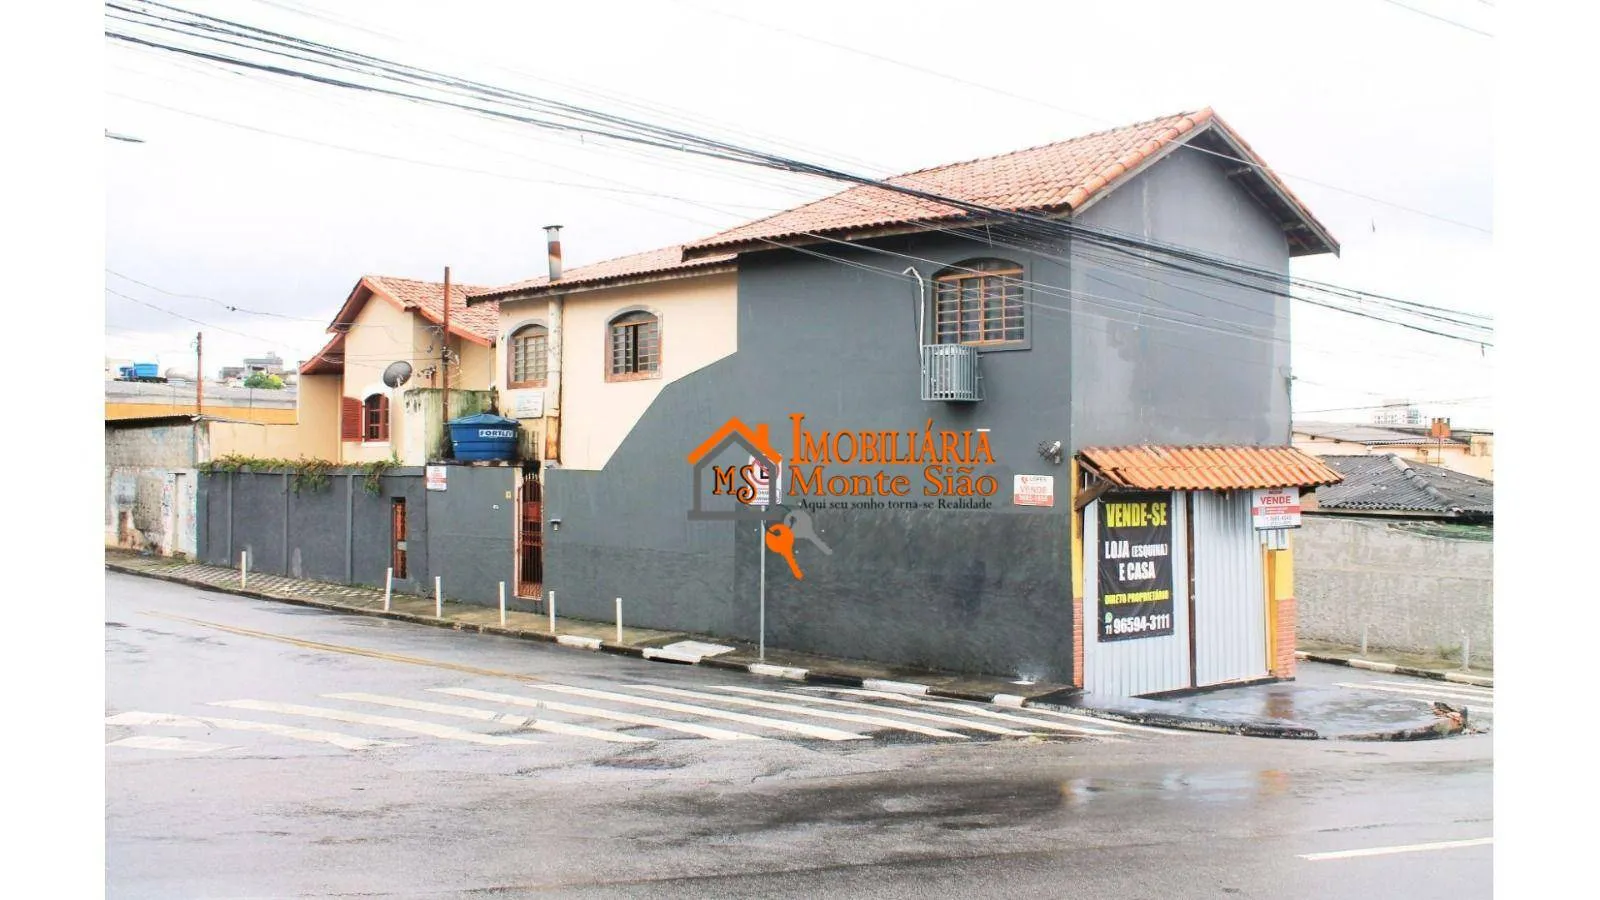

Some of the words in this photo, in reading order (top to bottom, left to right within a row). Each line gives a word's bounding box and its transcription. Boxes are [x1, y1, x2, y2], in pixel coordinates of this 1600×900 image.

[1260, 496, 1292, 504] VENDE
[1105, 502, 1167, 528] VENDE-SE
[1105, 540, 1130, 559] LOJA
[1119, 562, 1126, 582] E
[1127, 561, 1156, 581] CASA
[1104, 593, 1127, 605] DIRETO
[1113, 613, 1170, 635] 96594-3111
